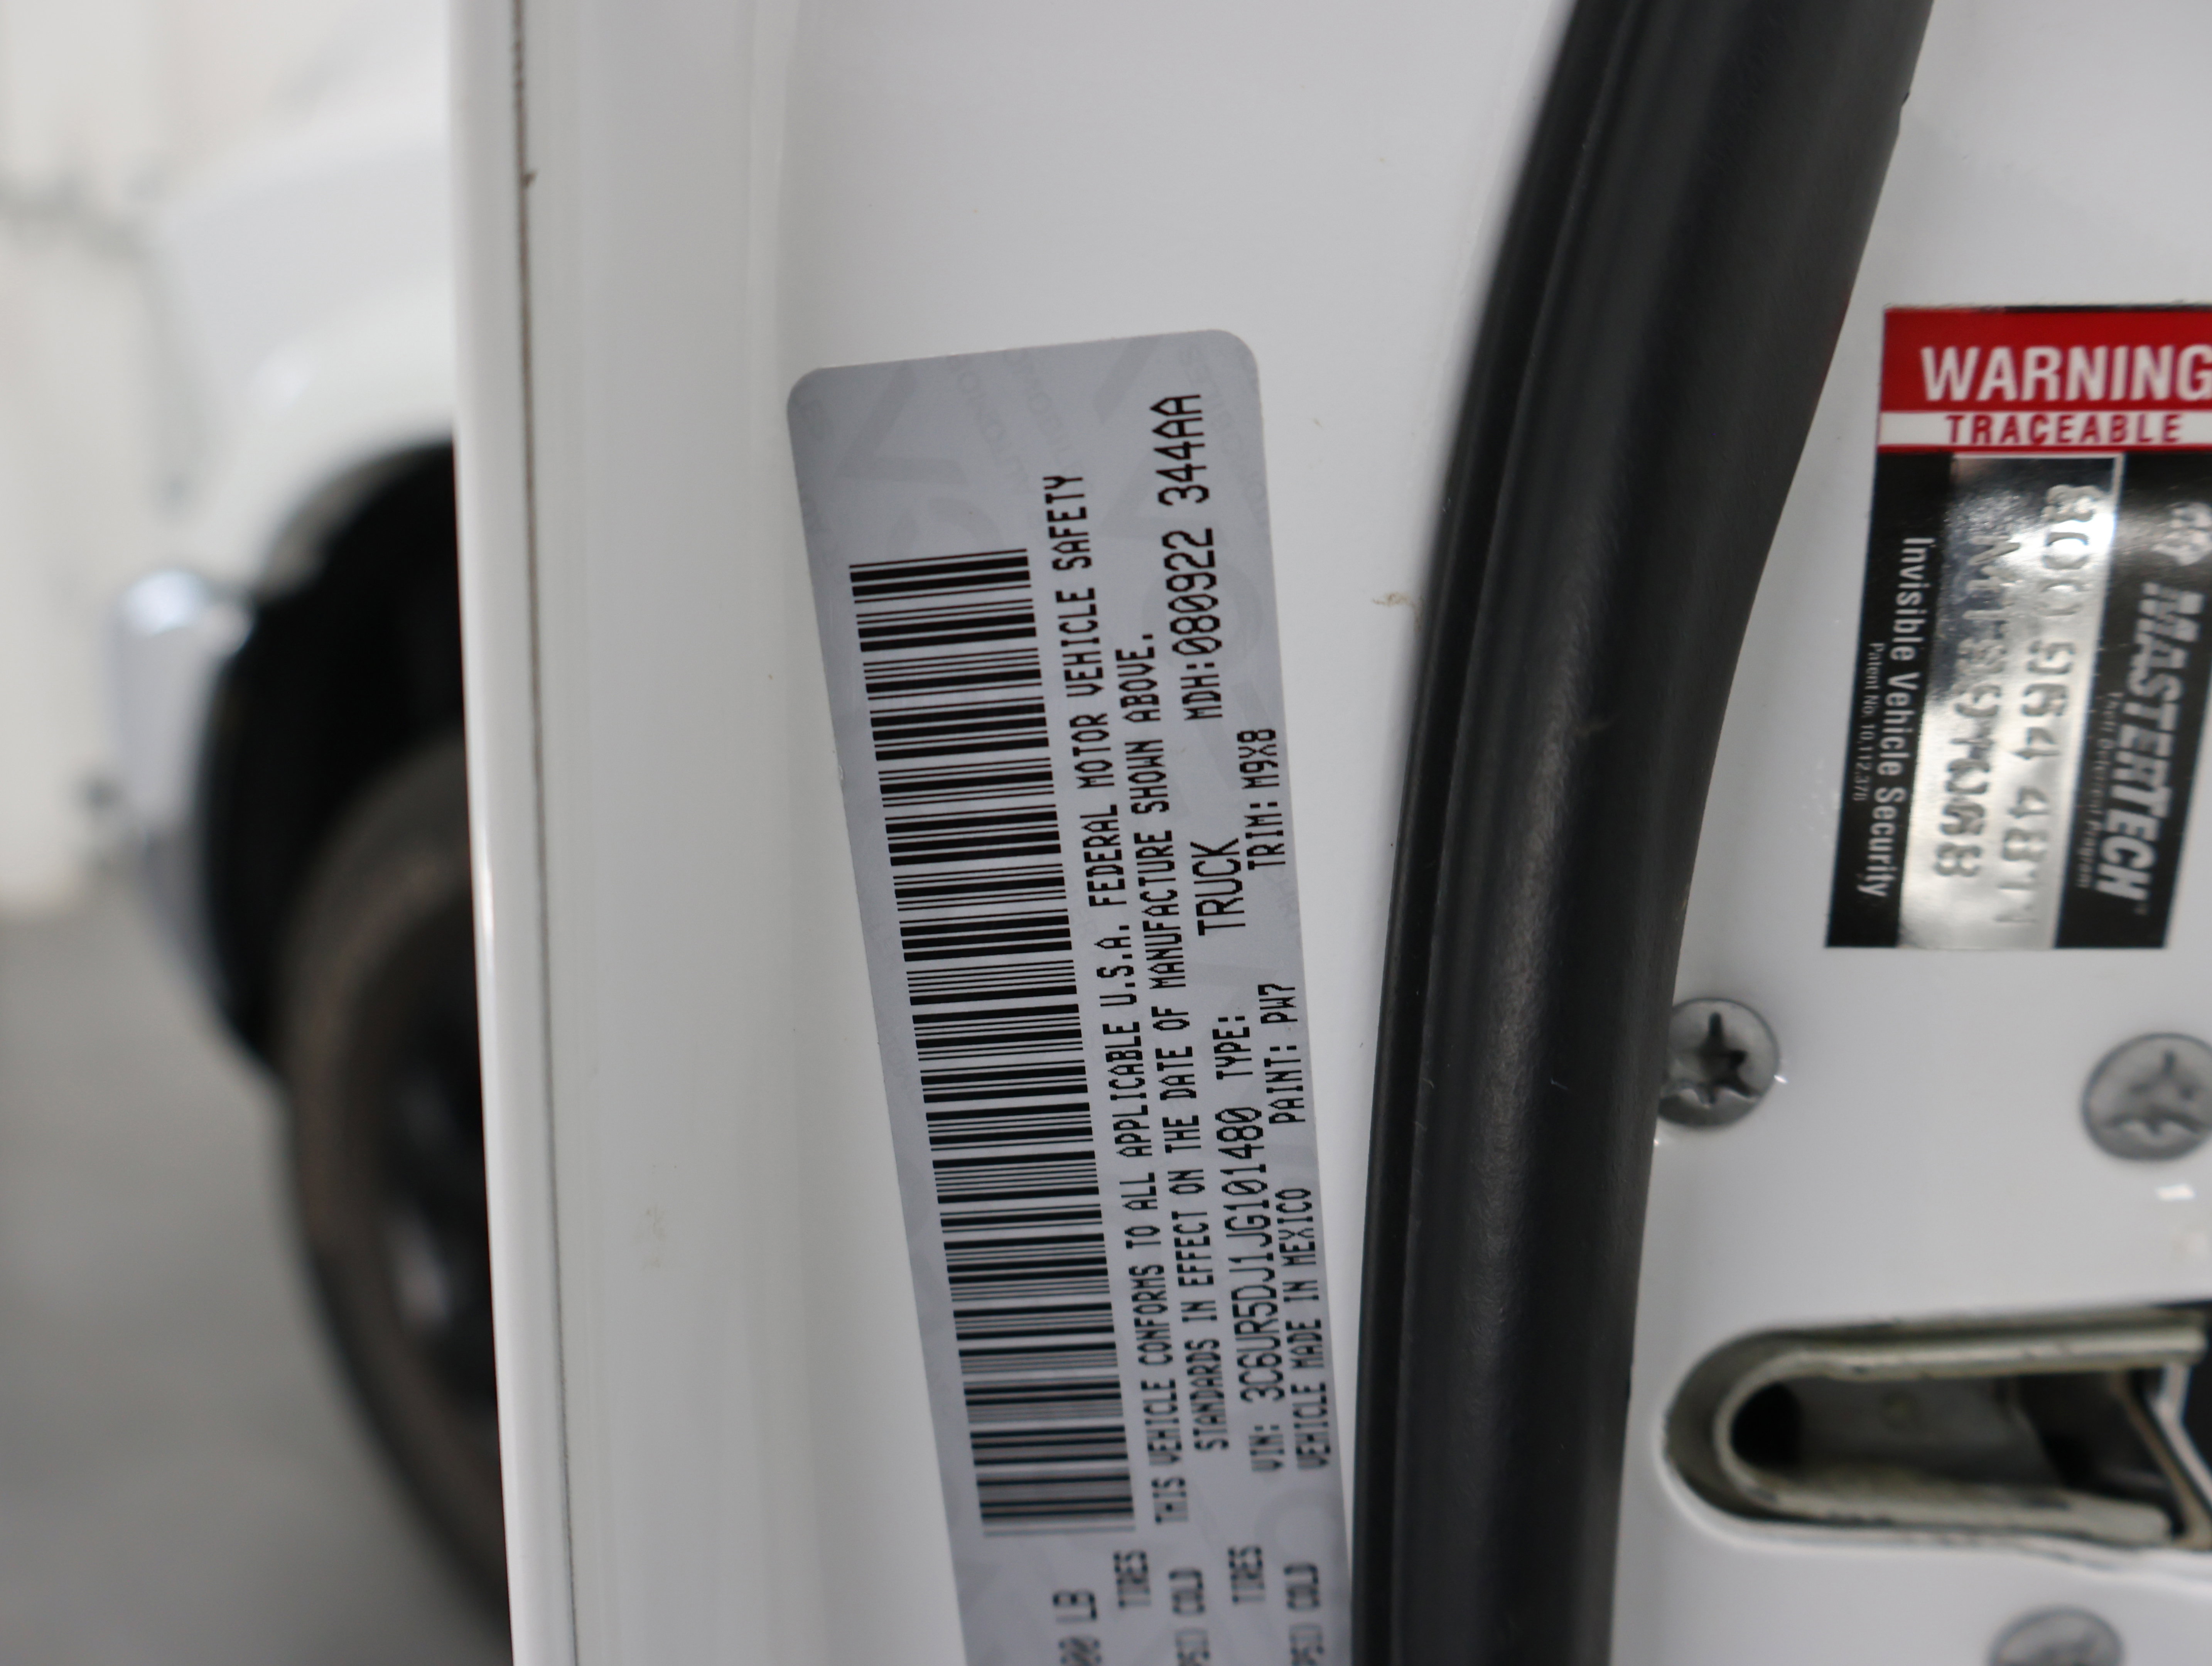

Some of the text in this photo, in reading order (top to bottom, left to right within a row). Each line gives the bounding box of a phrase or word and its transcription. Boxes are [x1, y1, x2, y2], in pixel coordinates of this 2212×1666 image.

[1920, 344, 2212, 401] WARNING
[1149, 393, 1210, 506] 344AA
[1945, 414, 2182, 445] TRACEABLE
[1042, 475, 1092, 570] SAFETY
[1055, 587, 1104, 697] VEHICLE
[1864, 642, 1885, 690] Patent
[1856, 537, 1936, 897] Invisible Vehicle Security
[2011, 641, 2078, 760] 964
[1068, 712, 1115, 788] MOTOR
[1080, 803, 1127, 906] FEDERAL
[1190, 838, 1246, 936] TRUCK
[1094, 924, 1137, 1007] U.S.A.
[1115, 633, 1229, 1450] STANDARDS IN EFFECT ON THE DATE OF MANUFACTURE SHOWN ABOVE.
[1212, 1015, 1254, 1079] TYPE:
[1102, 1021, 1152, 1157] APPLICABLE
[1237, 728, 1331, 1470] VEHICLE MADE IN MEXICO PAINT: PW7 TRIM: M9X8
[1119, 1172, 1158, 1211] ALL
[1124, 1224, 1161, 1249] TO
[1215, 1106, 1285, 1403] 3C6UR5DJ1JG101480
[1128, 1264, 1174, 1365] CONFORMS
[1140, 1379, 1182, 1465] VEHICLE
[1248, 1424, 1286, 1472] VIN:
[1151, 1477, 1188, 1524] THIS
[1052, 1590, 1097, 1623] LB
[1113, 1550, 1151, 1608] TIRES
[1228, 1545, 1266, 1604] TIRES
